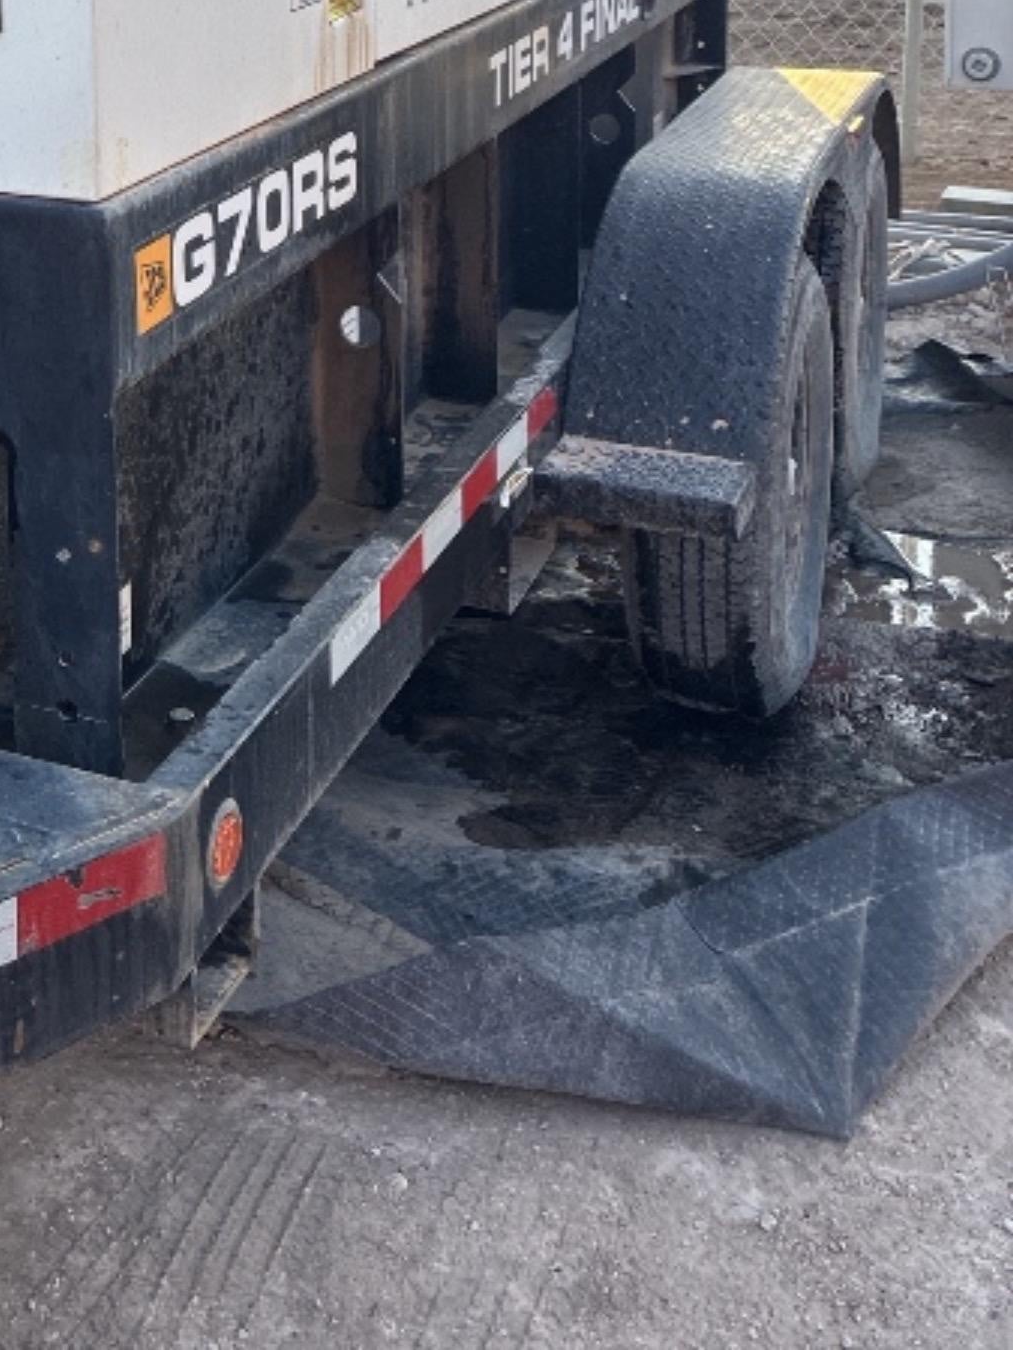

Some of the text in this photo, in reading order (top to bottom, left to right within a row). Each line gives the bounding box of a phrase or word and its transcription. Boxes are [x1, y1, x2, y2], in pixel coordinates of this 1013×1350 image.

[489, 25, 550, 107] TIER
[557, 10, 574, 61] 4
[172, 130, 358, 308] G70RS
